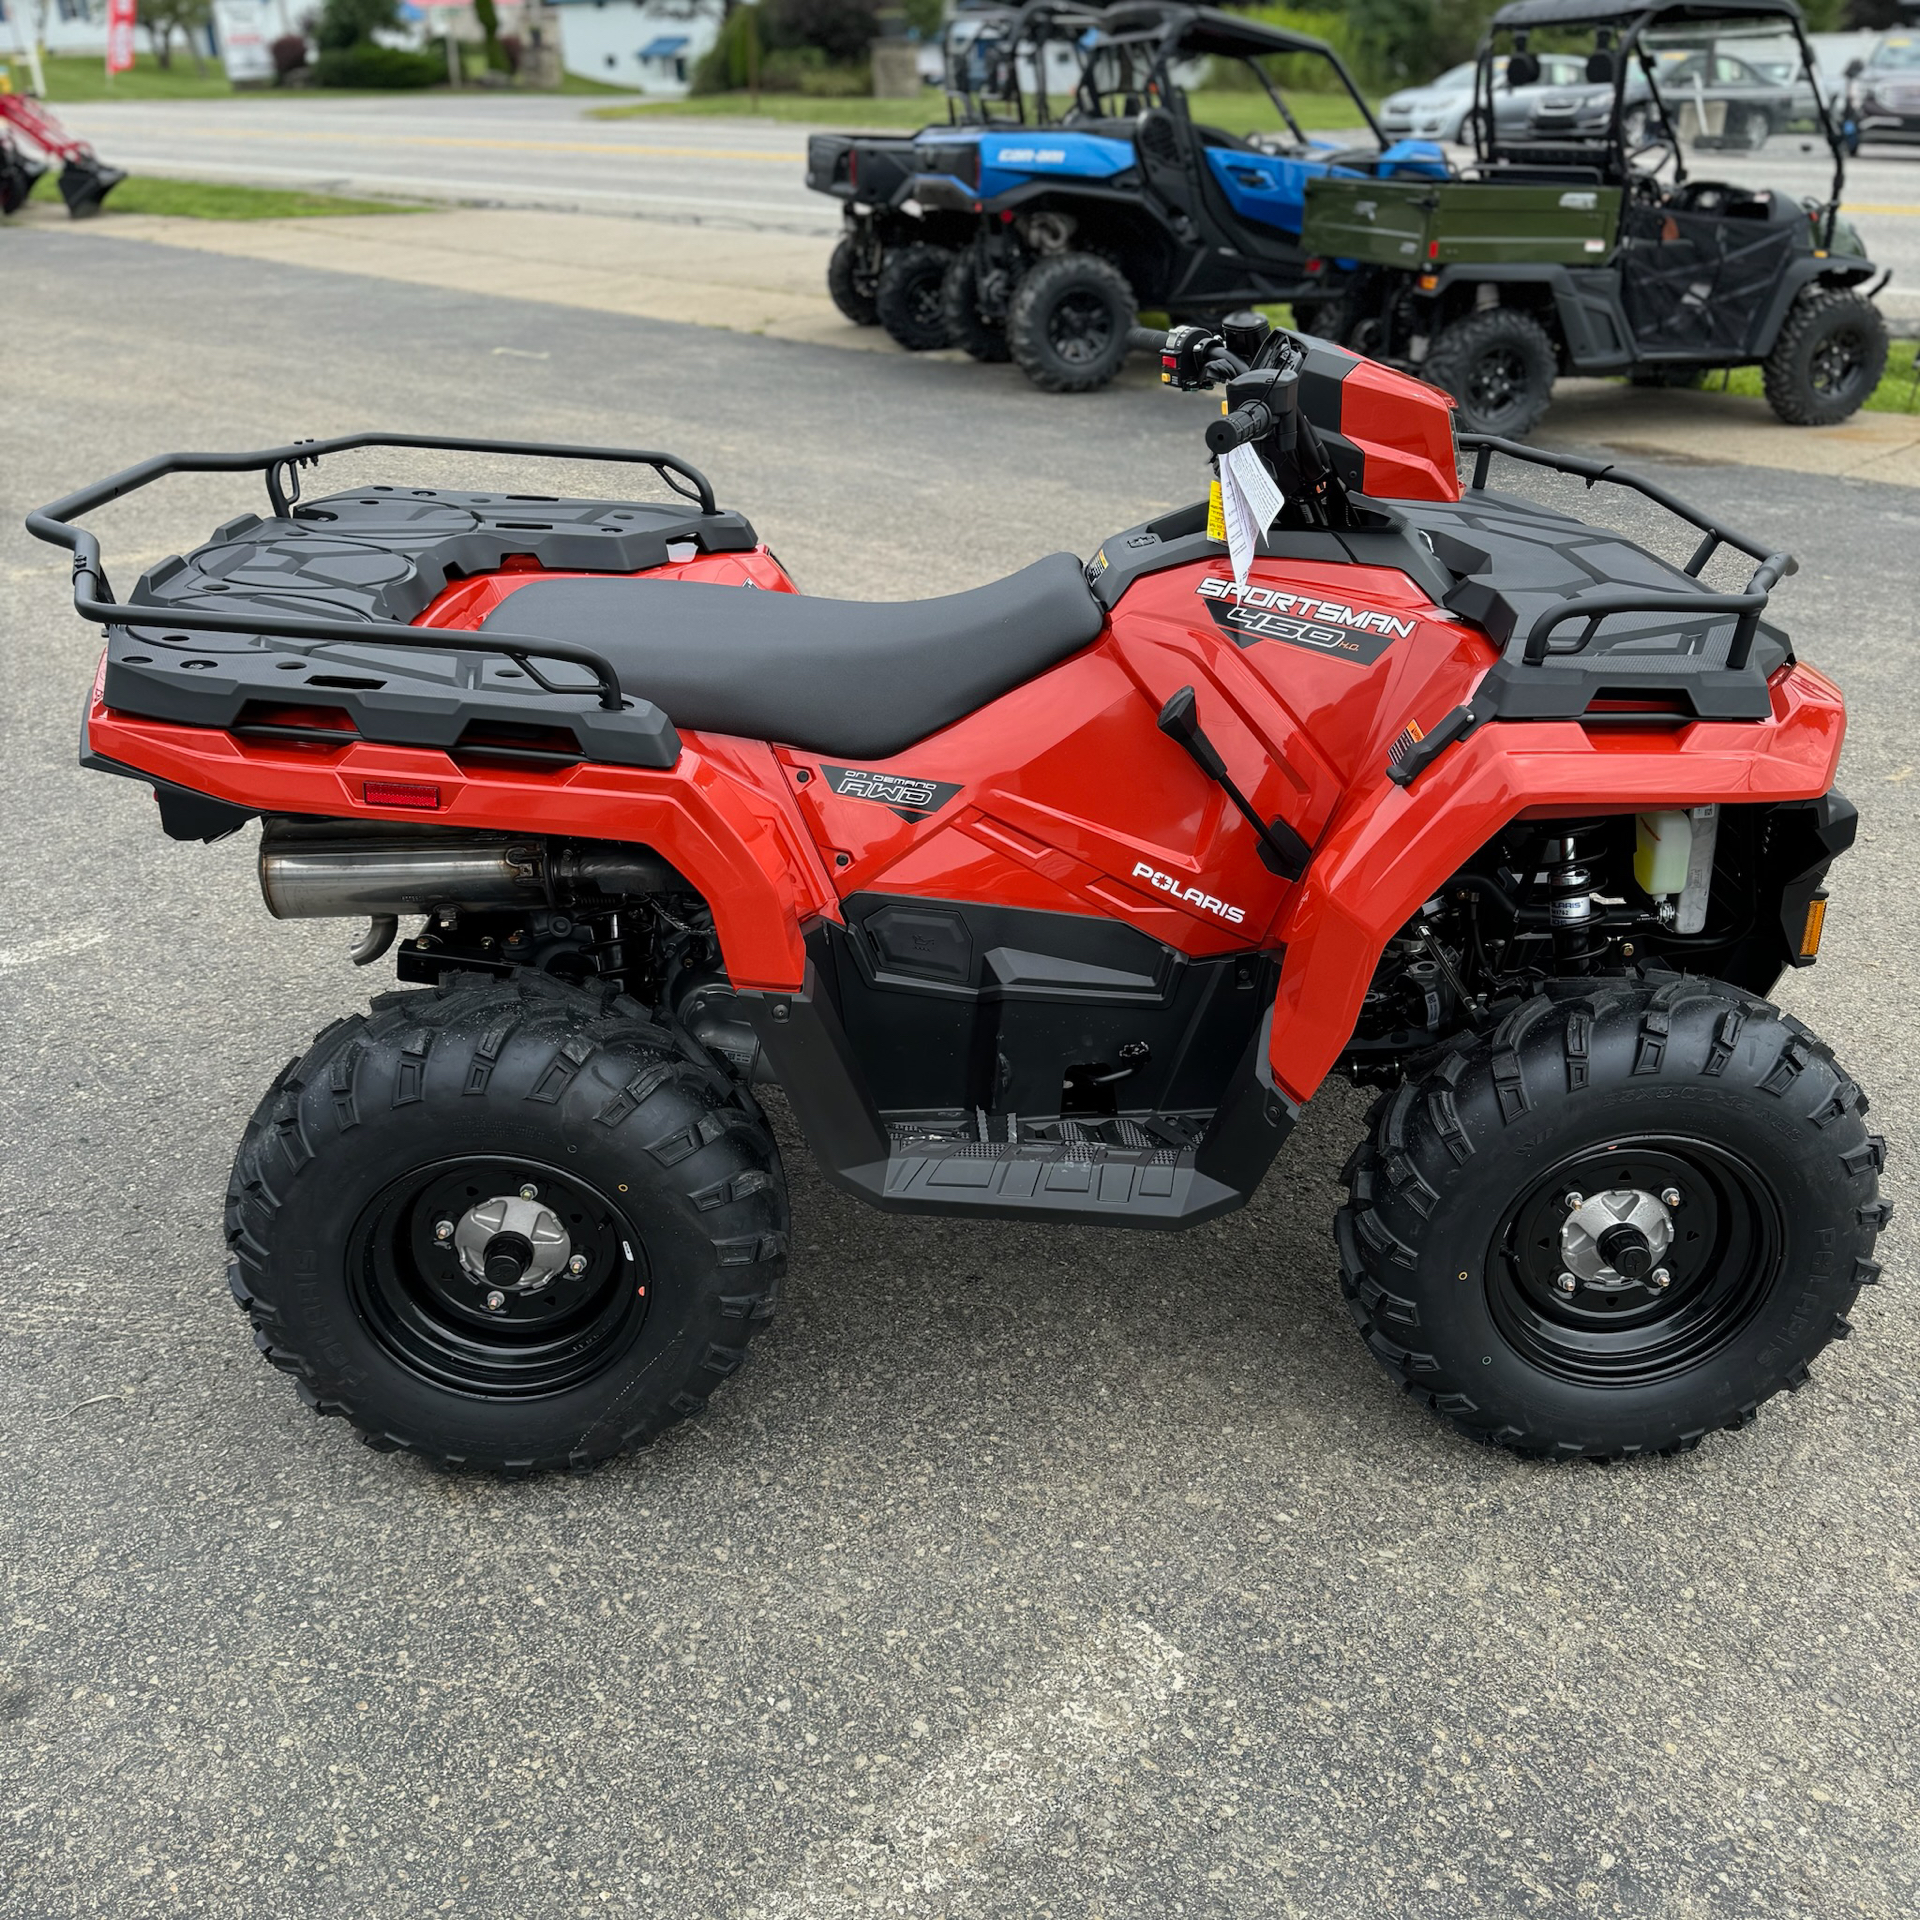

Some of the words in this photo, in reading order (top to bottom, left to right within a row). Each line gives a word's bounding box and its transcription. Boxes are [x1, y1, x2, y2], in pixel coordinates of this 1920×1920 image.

[1195, 577, 1418, 639] SPORTSMAN
[1227, 607, 1345, 648] 450
[837, 778, 932, 806] AWD
[873, 775, 937, 790] DEMAND
[1132, 862, 1246, 924] POLARIS
[1551, 901, 1581, 909] LARIS
[1755, 1226, 1836, 1367] POLARIS
